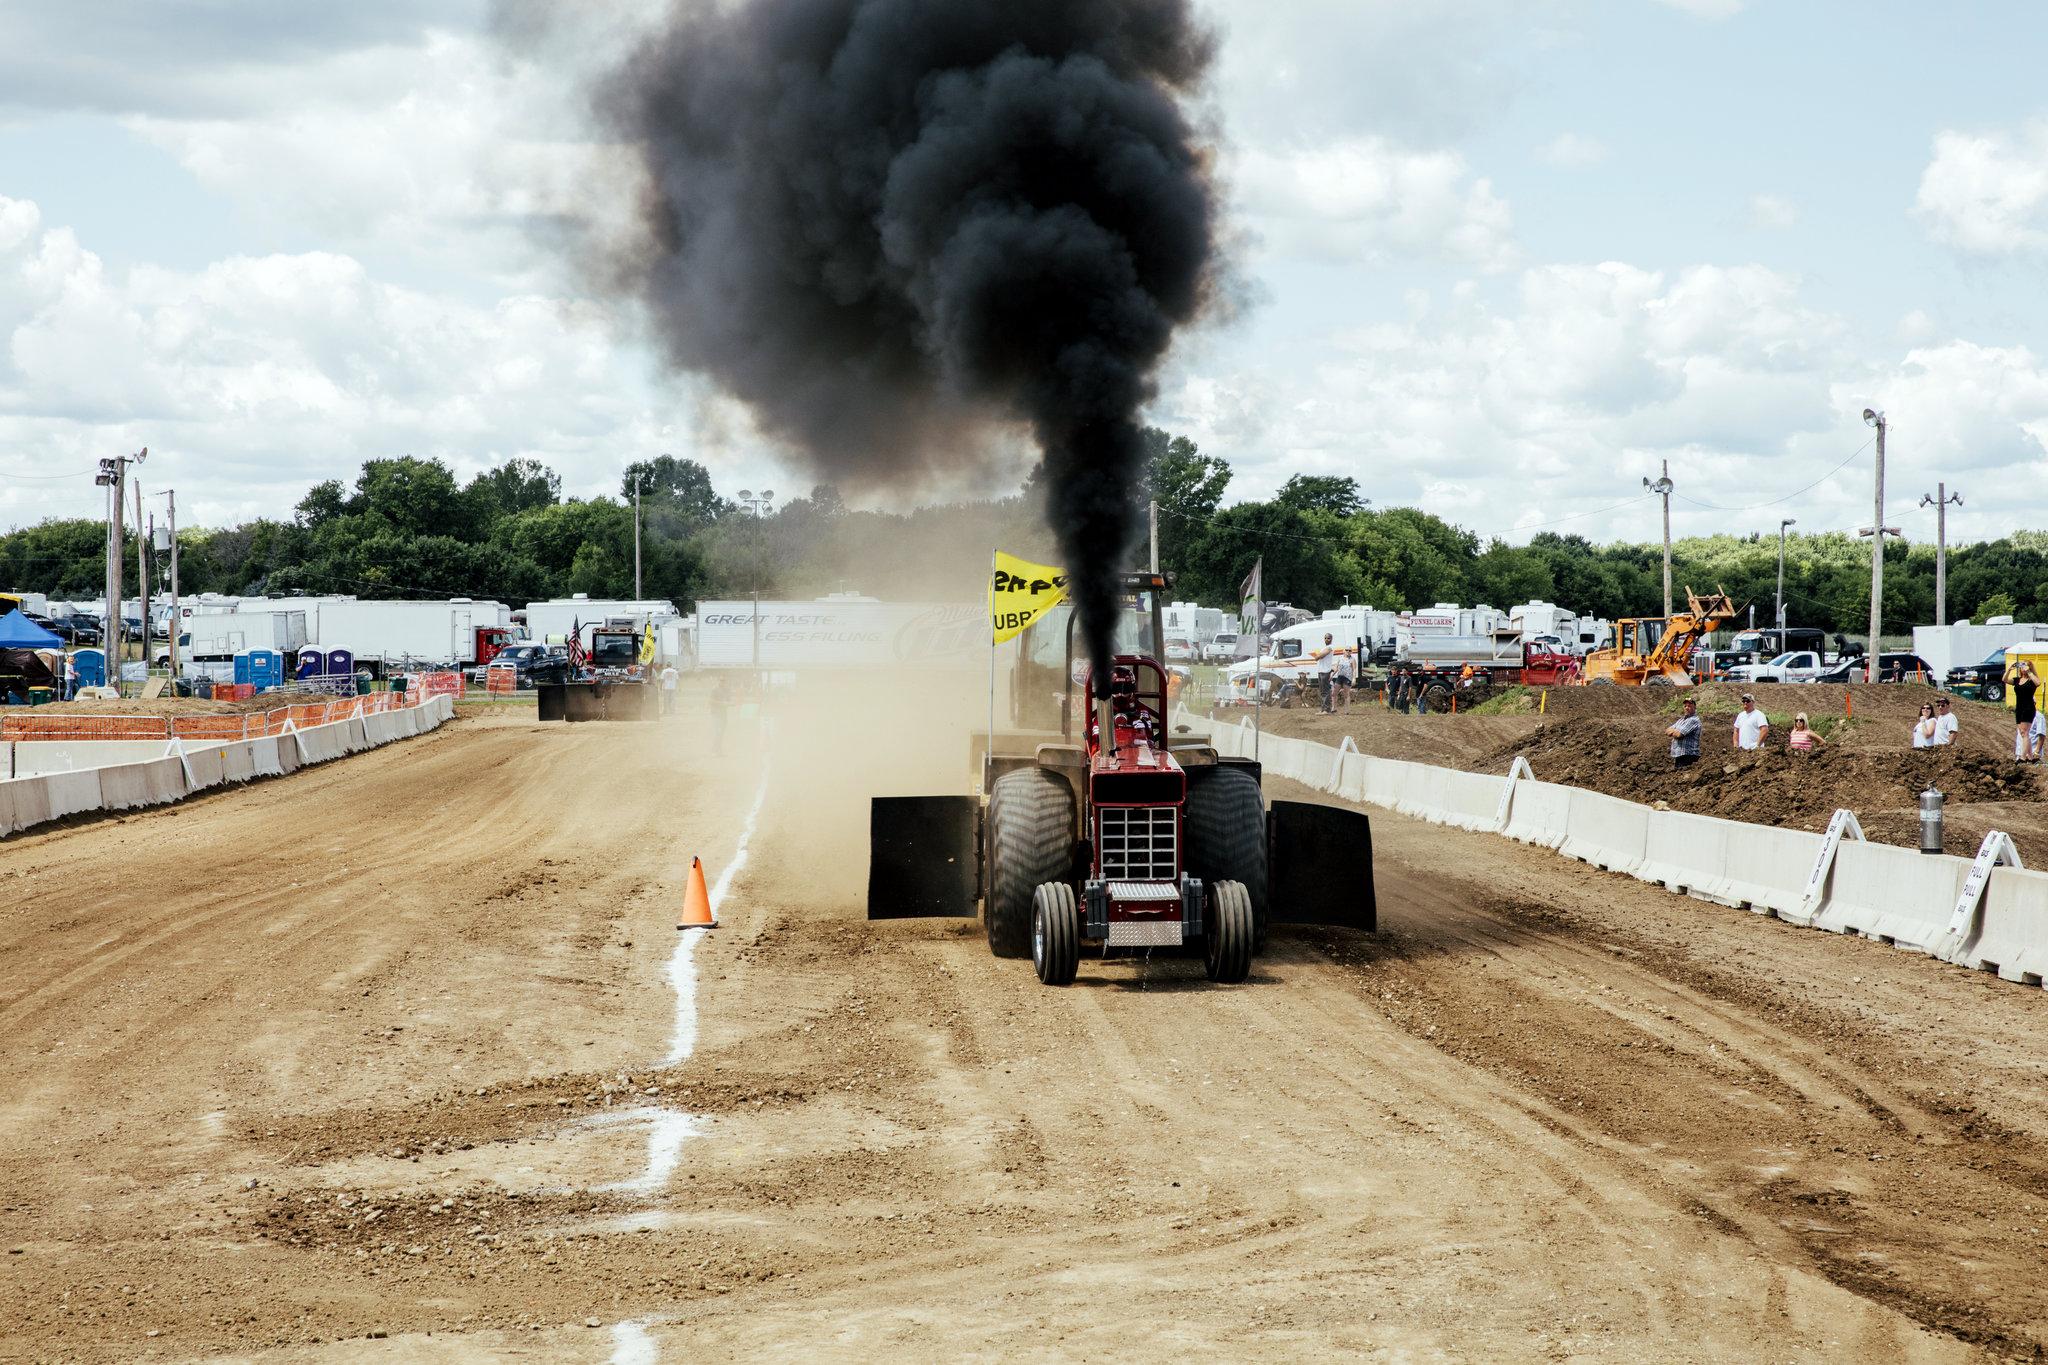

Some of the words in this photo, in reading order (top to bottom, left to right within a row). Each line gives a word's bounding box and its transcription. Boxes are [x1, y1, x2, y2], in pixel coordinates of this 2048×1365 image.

[705, 614, 769, 625] GREAT
[758, 632, 804, 642] LESS
[808, 632, 881, 642] FILLING
